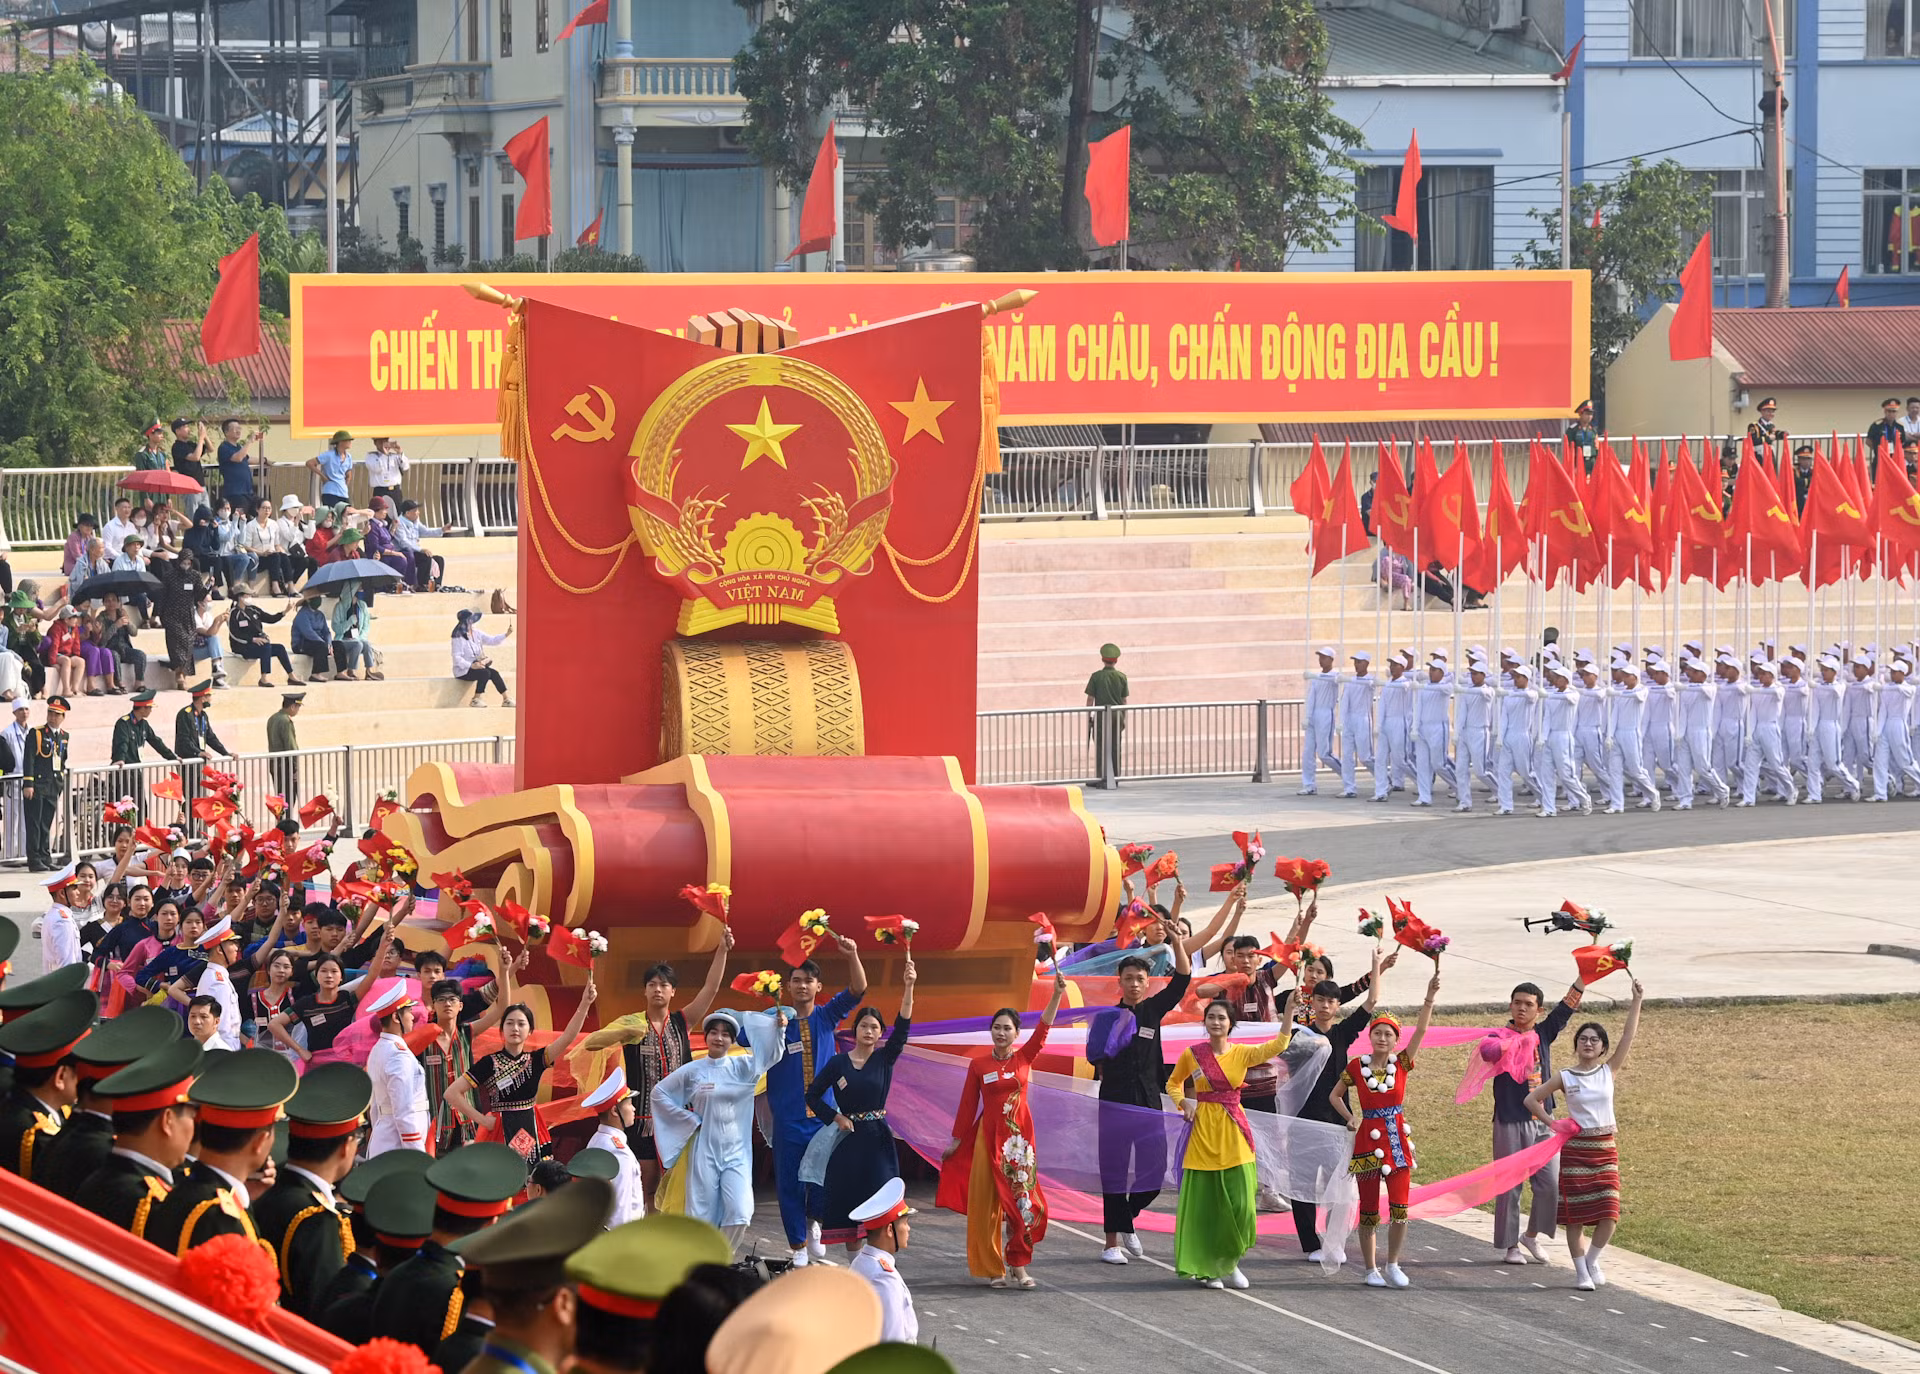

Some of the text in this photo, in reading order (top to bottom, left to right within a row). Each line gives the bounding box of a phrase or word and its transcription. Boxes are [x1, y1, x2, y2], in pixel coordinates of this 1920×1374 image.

[369, 309, 459, 392] CHIẾN
[985, 312, 1056, 382] NĂM
[1067, 311, 1158, 388] CHÂU,
[1169, 303, 1251, 381] CHẤN
[1260, 311, 1346, 393] ĐỘNG
[1355, 323, 1409, 392] ĐỊA
[719, 579, 736, 588] CỘNG
[777, 573, 790, 581] CHỦ
[725, 583, 805, 601] VIỆT NAM
